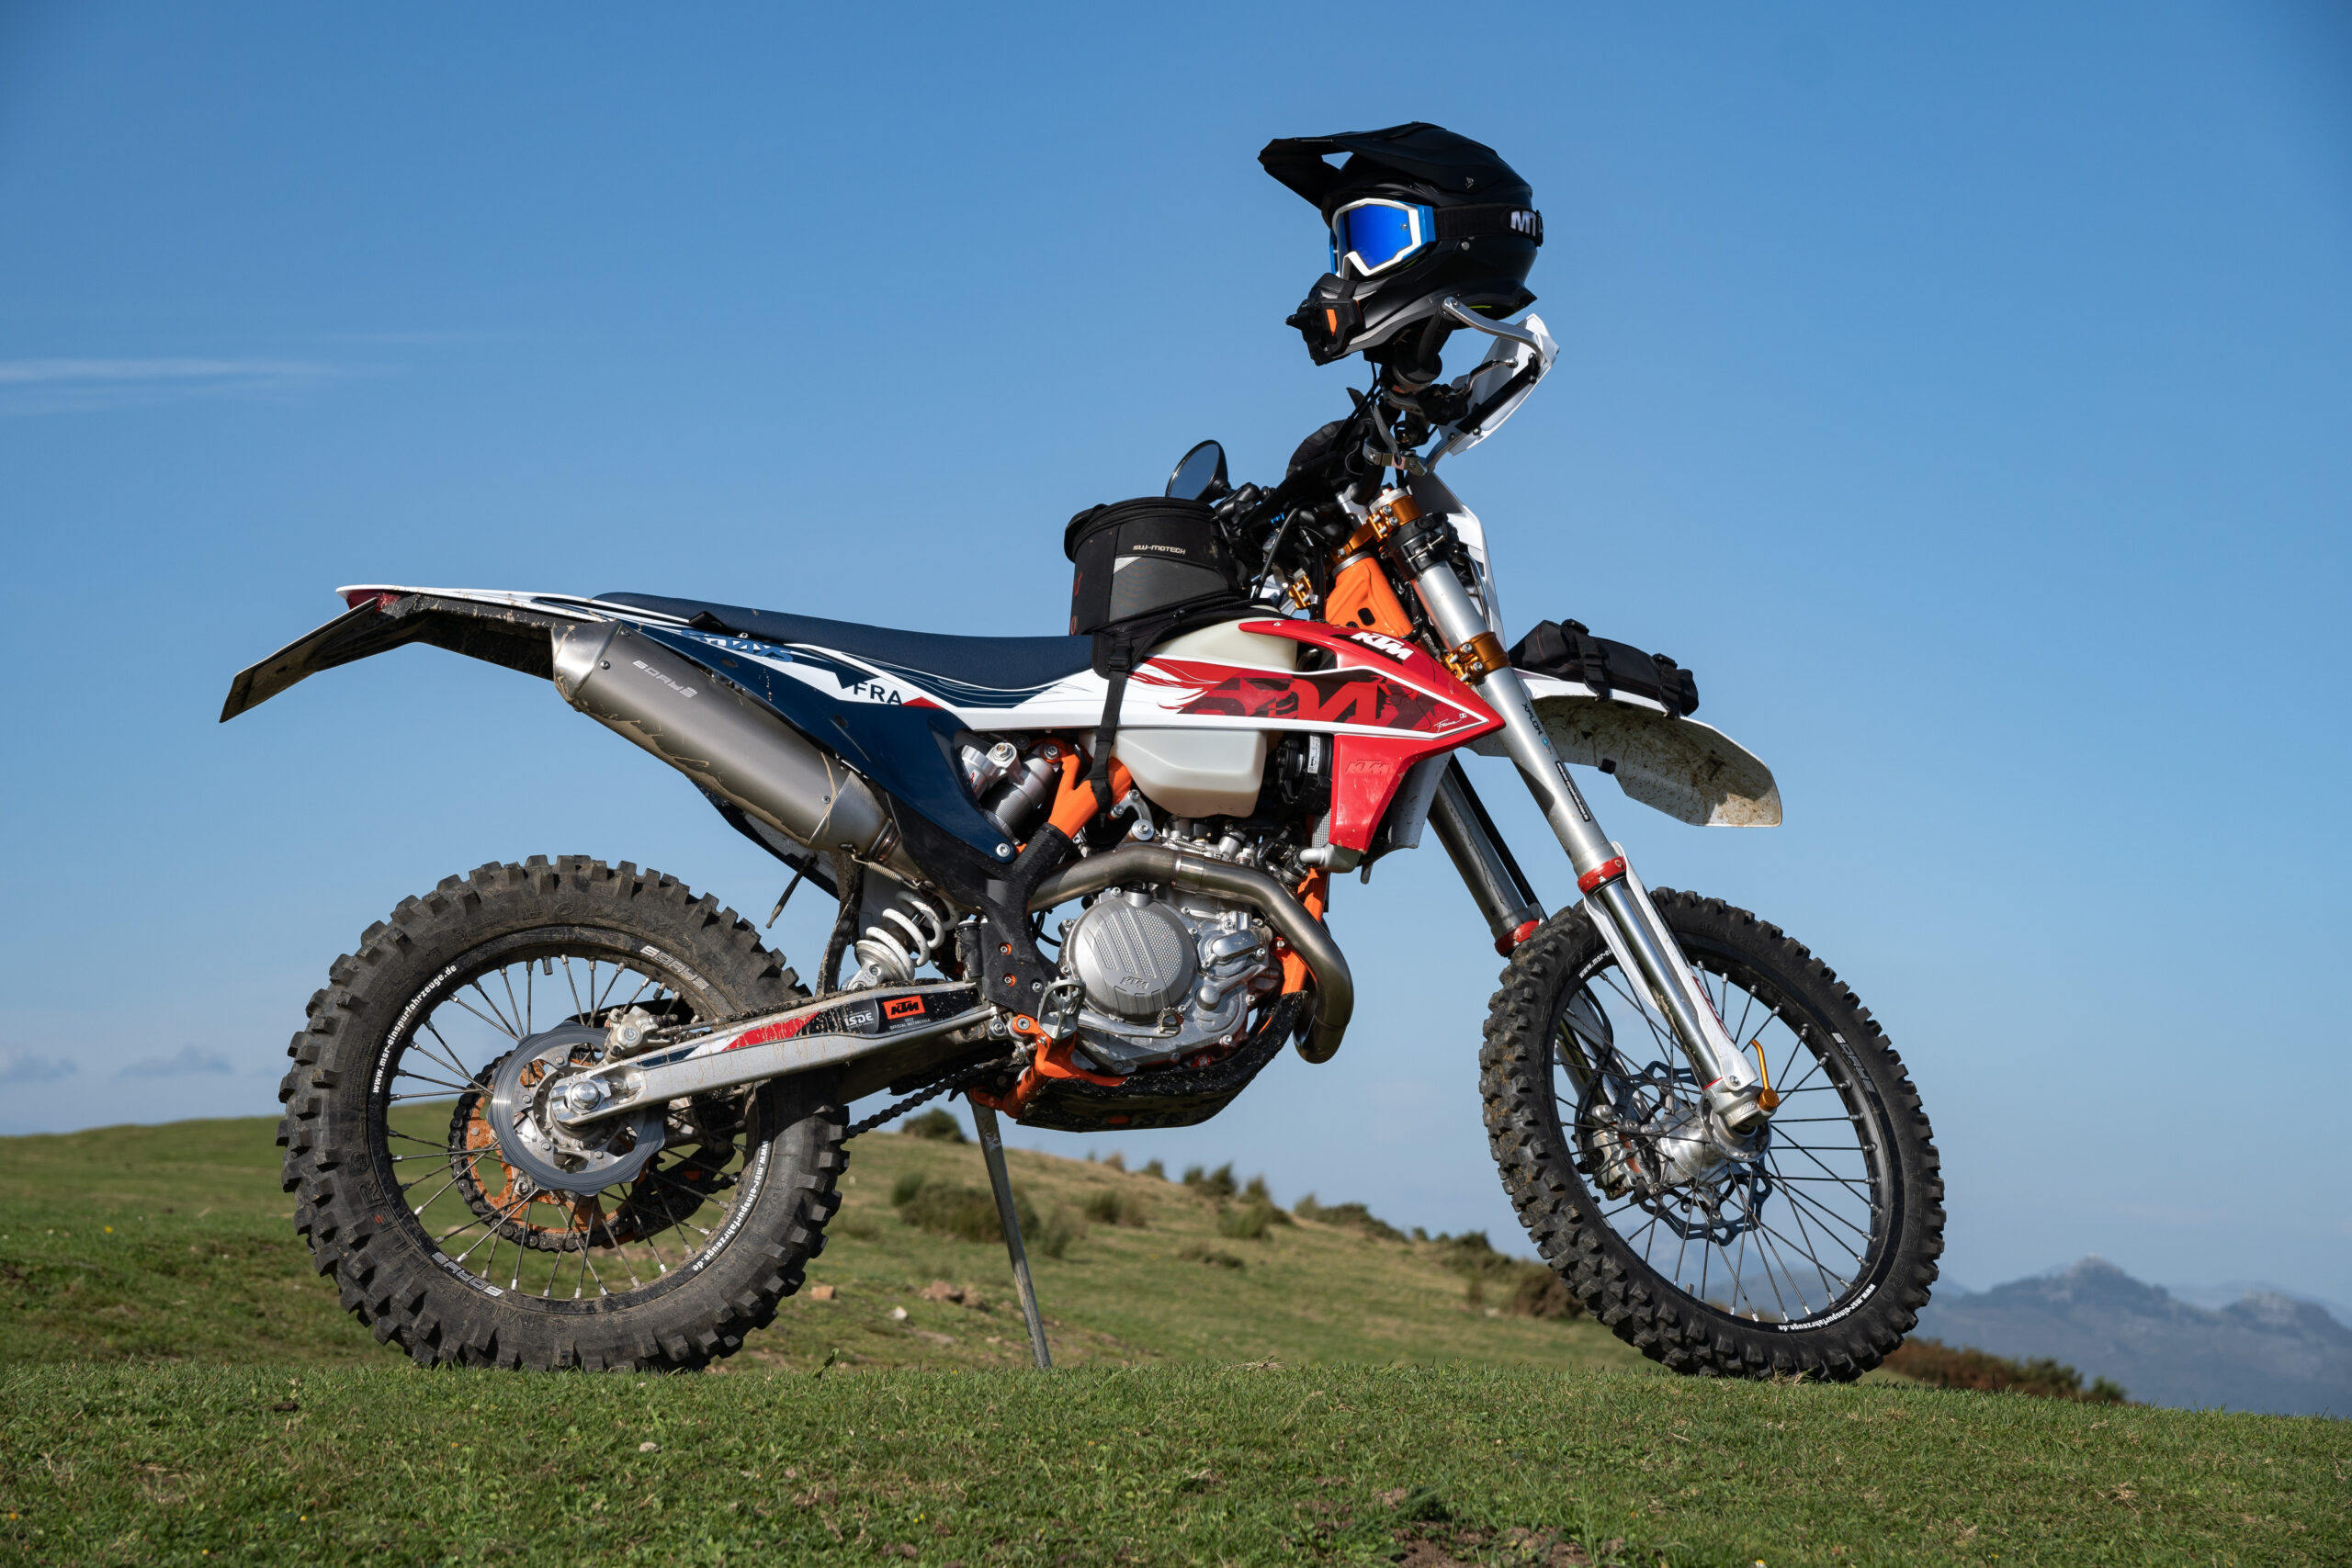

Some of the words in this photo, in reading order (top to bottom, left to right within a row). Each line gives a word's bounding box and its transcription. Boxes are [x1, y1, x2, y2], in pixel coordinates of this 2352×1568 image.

[1133, 545, 1186, 556] SW-MOTECH
[1351, 632, 1414, 660] KTM
[854, 682, 902, 705] FRA
[1345, 760, 1389, 773] KTM
[639, 945, 709, 990] 6DAYS
[372, 964, 457, 1093] www.msr-einspurfahrzeuge.de
[890, 1002, 919, 1015] KTM
[1831, 1032, 1875, 1093] 6DAYS
[692, 1140, 769, 1271] www.msr-einspurfahrzeuge.de
[431, 1251, 504, 1297] 6DAYS
[1778, 1283, 1876, 1332] www.msr-einspurfahrzeuge.de
